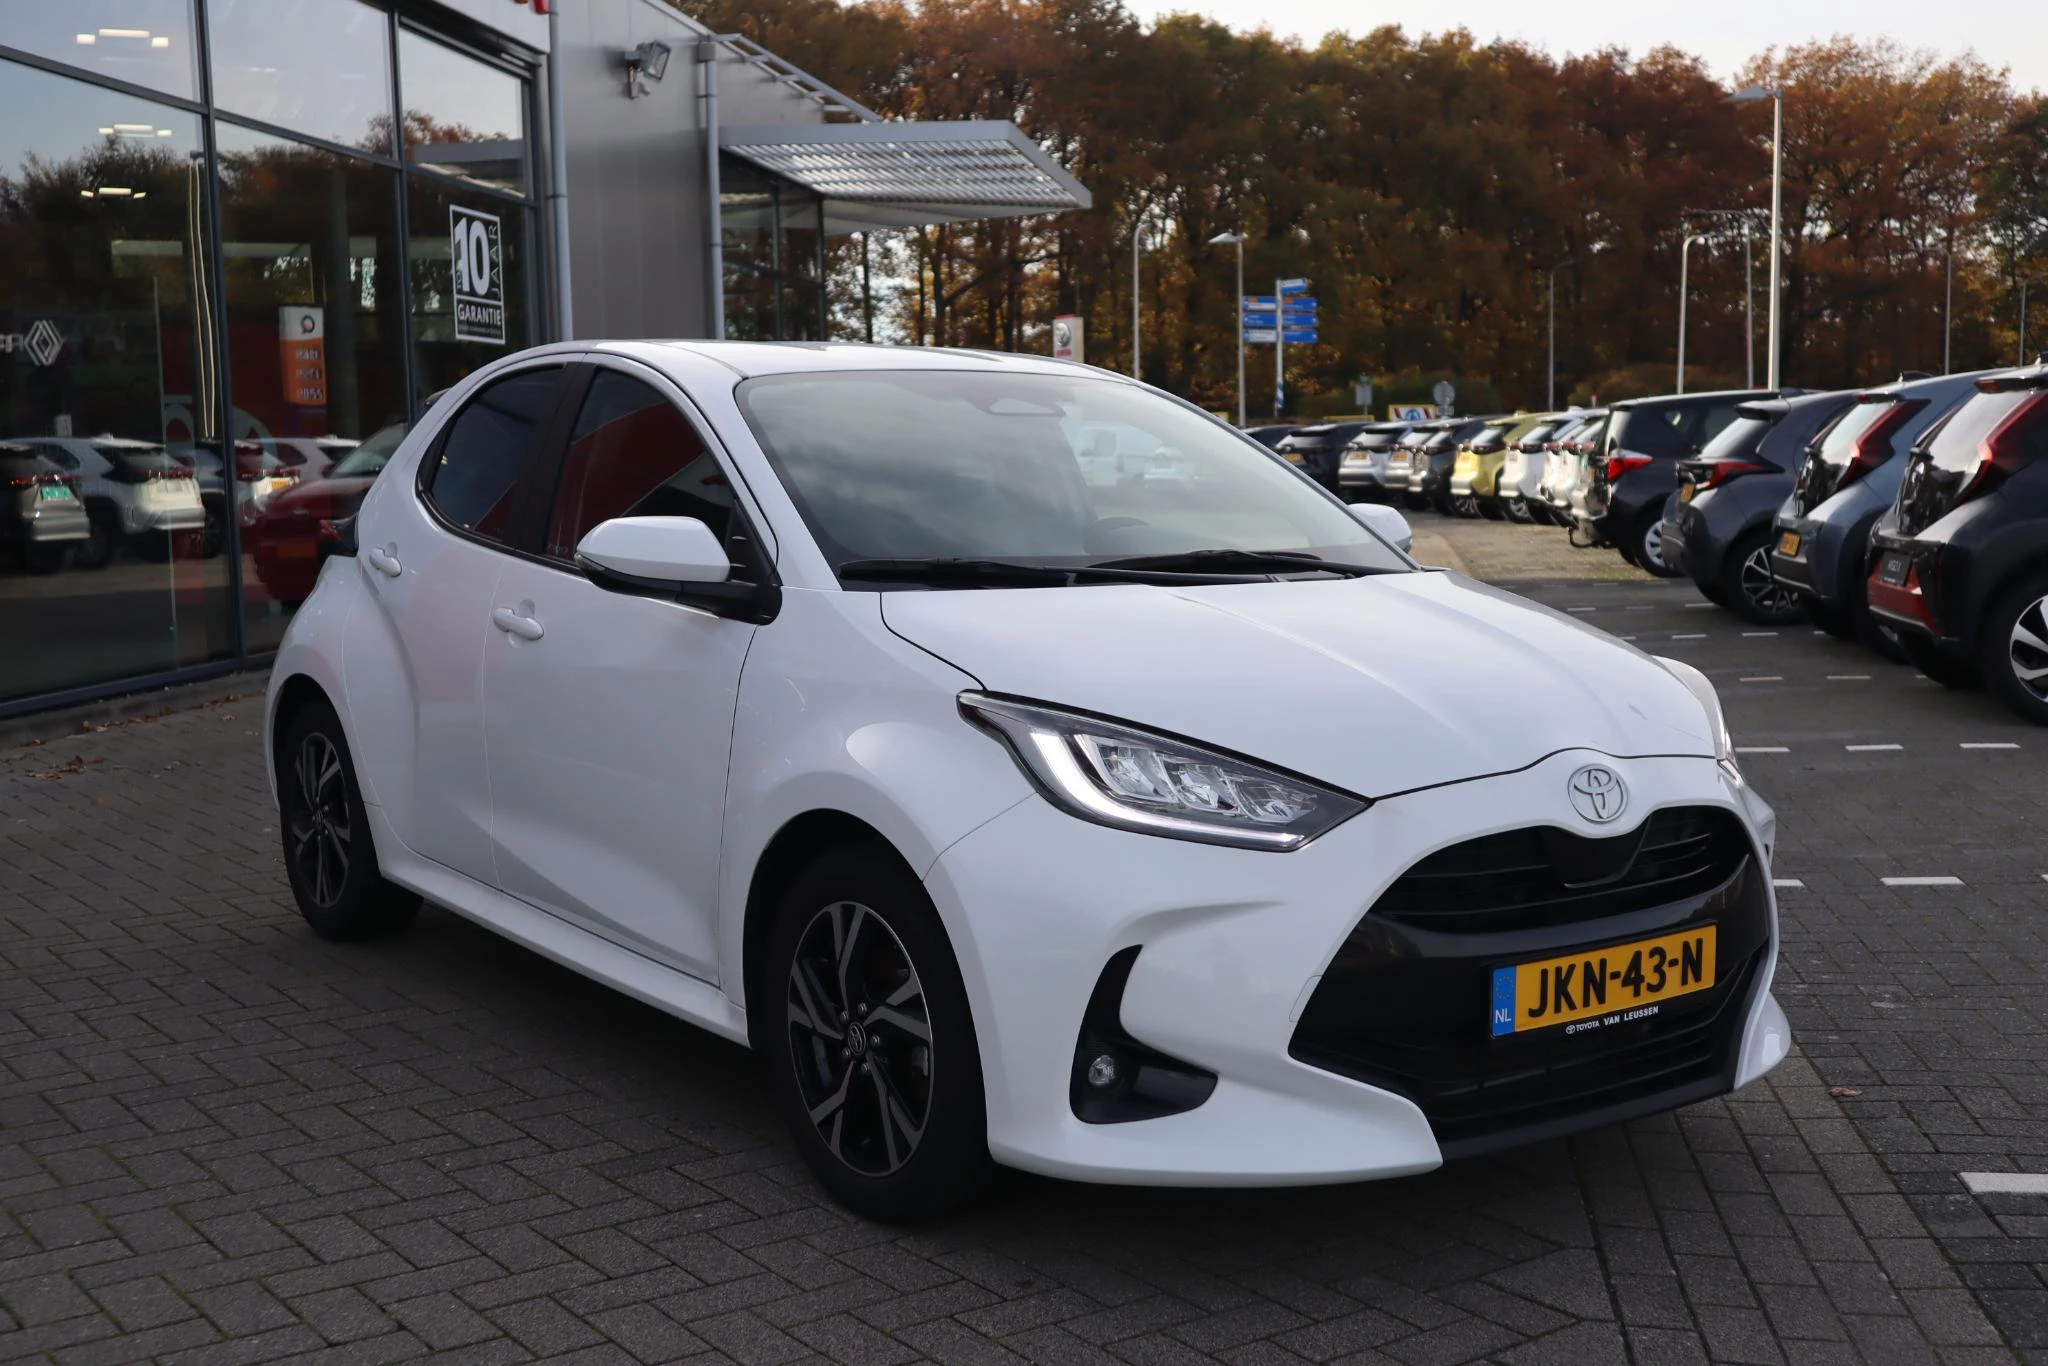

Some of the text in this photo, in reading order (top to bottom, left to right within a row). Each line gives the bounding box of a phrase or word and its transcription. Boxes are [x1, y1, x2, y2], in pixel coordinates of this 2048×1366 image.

[454, 217, 490, 296] 10
[489, 225, 500, 298] JAAR
[457, 303, 501, 325] GARANTIE
[1528, 937, 1703, 1018] JKN-43-N
[1495, 1008, 1511, 1023] NL
[1576, 1006, 1659, 1031] TOYOTA VAN LEUSSEN
